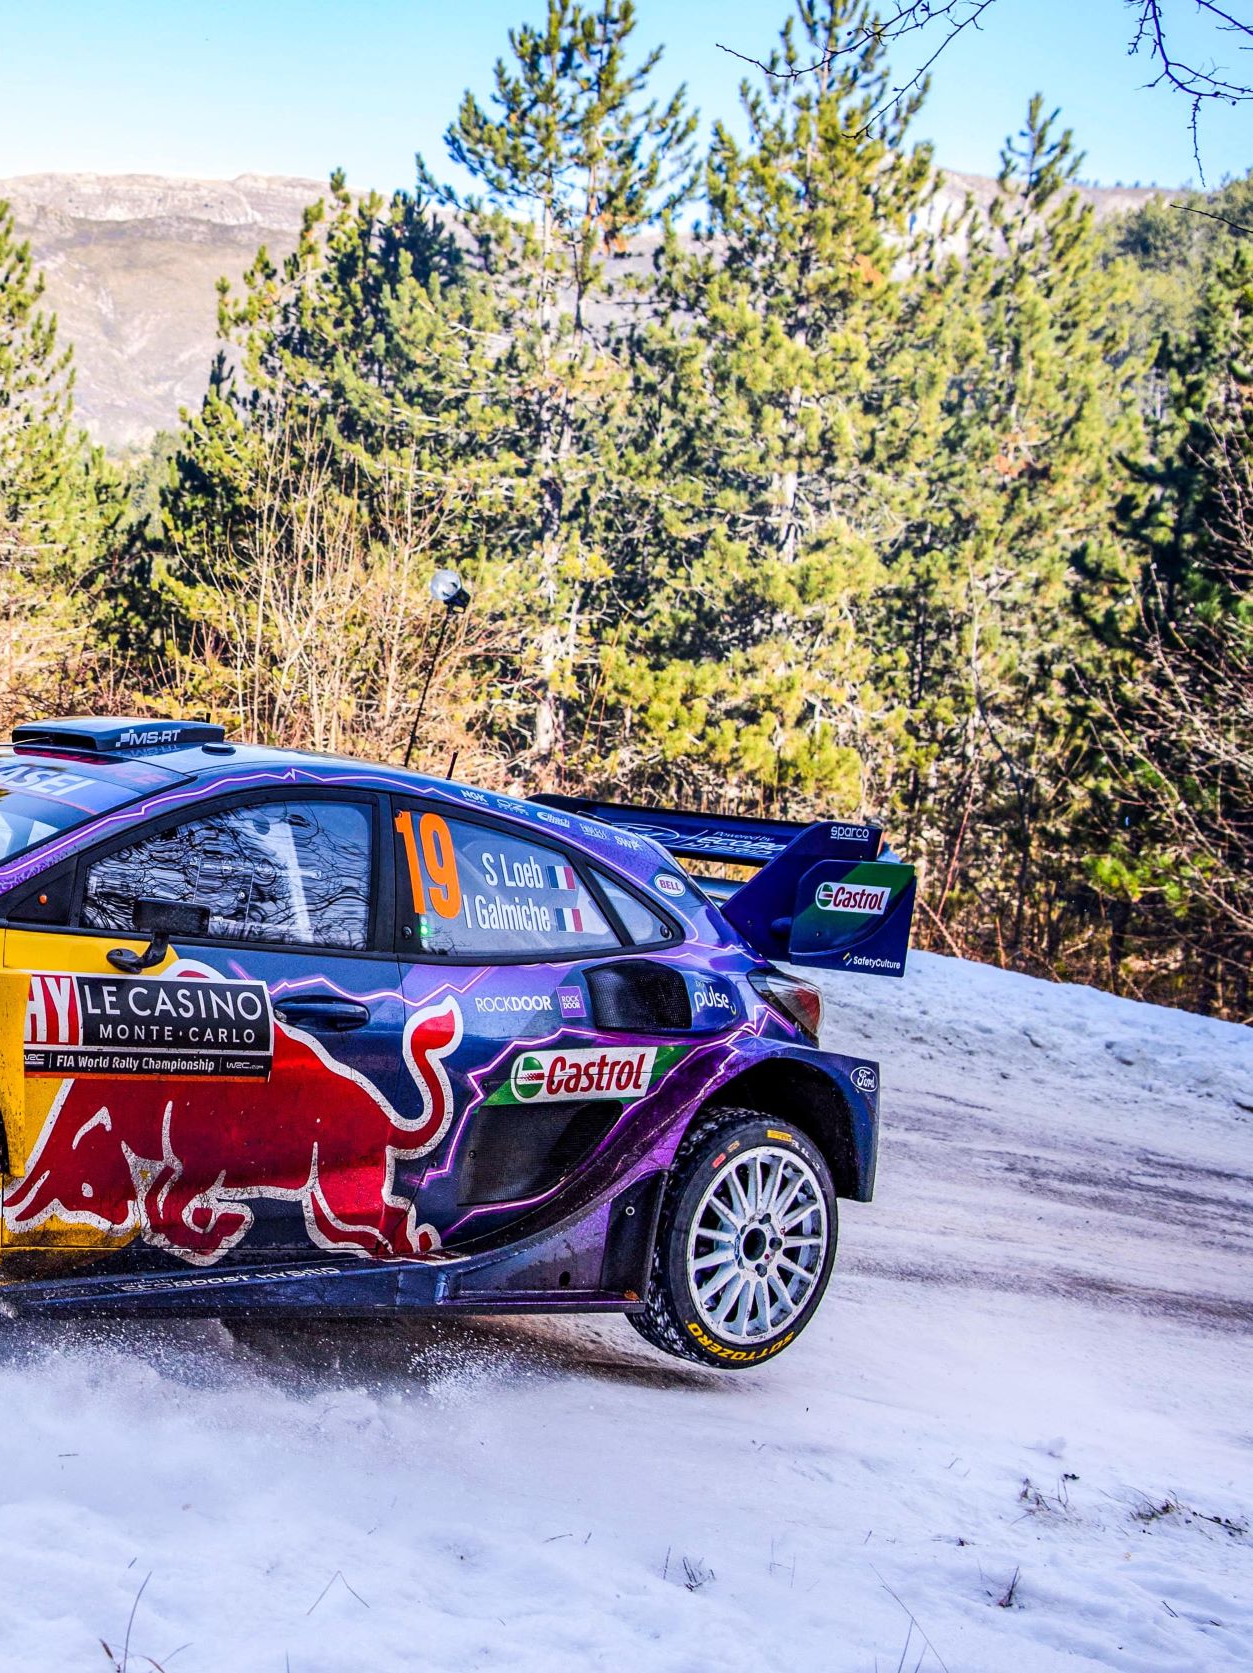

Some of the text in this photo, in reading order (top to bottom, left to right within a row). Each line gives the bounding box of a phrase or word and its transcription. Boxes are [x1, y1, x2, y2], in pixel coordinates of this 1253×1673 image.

[830, 825, 870, 839] sparco
[395, 810, 462, 919] 19
[481, 852, 544, 889] S Loeb
[658, 879, 682, 891] BELL
[833, 886, 885, 911] Castrol
[462, 894, 551, 932] I Galmiche
[853, 955, 901, 970] SafetyCulture
[83, 984, 263, 1021] LE CASINO
[474, 995, 553, 1012] ROCKDOOR
[561, 995, 580, 1003] ROCK
[562, 1001, 581, 1010] DOOR
[693, 985, 730, 1013] pulse
[99, 1024, 256, 1044] MONTE CARLO
[56, 1054, 215, 1073] FIA World Rally Championship
[546, 1053, 646, 1095] Castrol
